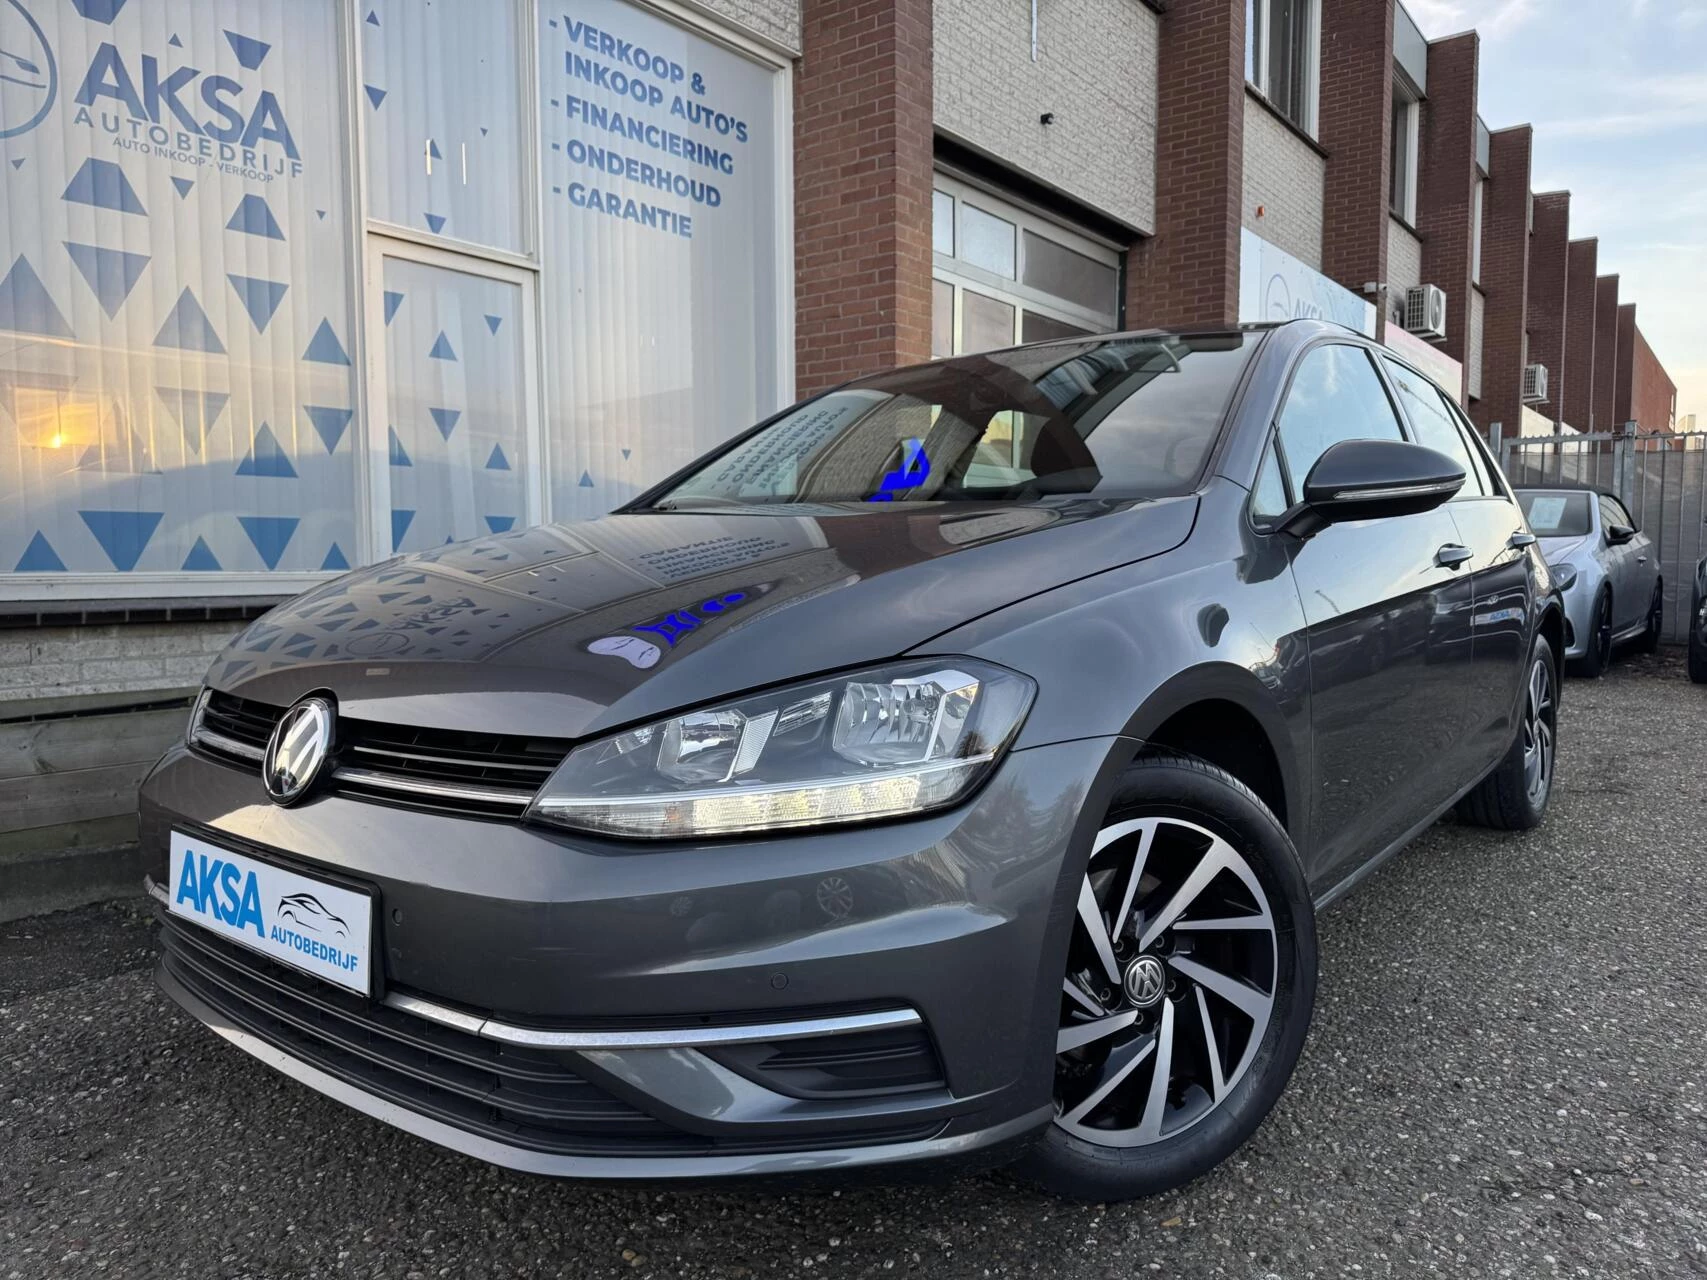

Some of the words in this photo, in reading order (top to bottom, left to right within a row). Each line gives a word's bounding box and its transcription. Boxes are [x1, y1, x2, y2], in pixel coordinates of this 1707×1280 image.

[564, 15, 685, 84] VERKOOP
[690, 72, 706, 96] &
[74, 41, 302, 160] AKSA
[565, 51, 664, 107] INKOOP
[670, 95, 748, 143] AUTO'S
[566, 94, 734, 175] FINANCIERING
[73, 106, 303, 178] AUTOBEDRIJF
[112, 136, 150, 154] AUTO
[153, 146, 205, 168] INKOOP
[217, 161, 274, 184] VERKOOP
[566, 139, 721, 208] ONDERHOUD
[567, 181, 693, 239] GARANTIE
[176, 849, 266, 939] AKSA
[270, 925, 359, 973] AUTOBEDRIJF
